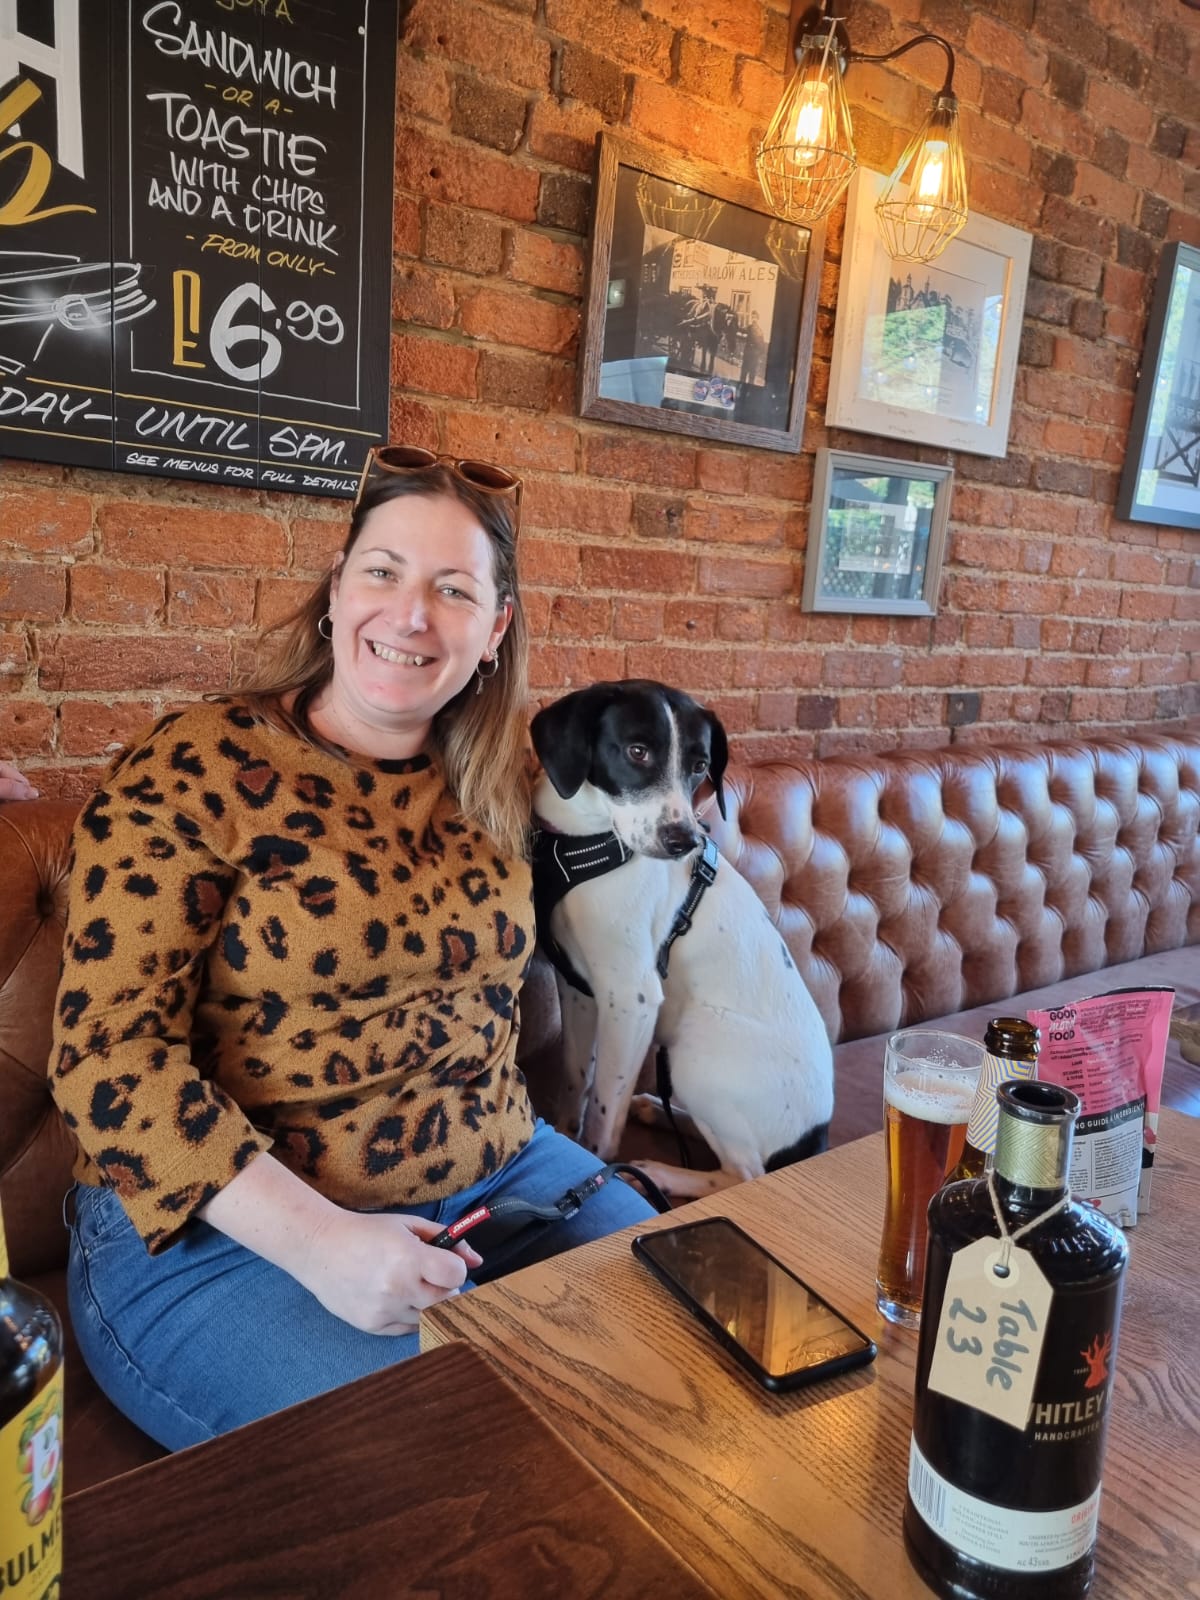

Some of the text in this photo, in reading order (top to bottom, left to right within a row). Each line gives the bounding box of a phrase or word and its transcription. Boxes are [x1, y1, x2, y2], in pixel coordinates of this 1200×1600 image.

[142, 1, 337, 109] SANDWICH
[146, 93, 327, 176] TOASTIE
[170, 151, 325, 215] WITH CHIPS
[148, 178, 339, 255] AND A DRINK
[739, 266, 776, 281] ALES
[135, 406, 250, 451] UNTIL
[126, 452, 160, 467] SEE
[163, 458, 219, 474] MENUS
[224, 465, 254, 480] FOR
[261, 470, 296, 484] FULL
[1049, 1009, 1077, 1021] GOOD
[1049, 1030, 1075, 1042] FOOD
[1088, 1118, 1108, 1128] GUIDE
[947, 1297, 987, 1356] 23
[986, 1298, 1038, 1391] Table
[1026, 1390, 1104, 1425] HITLEY
